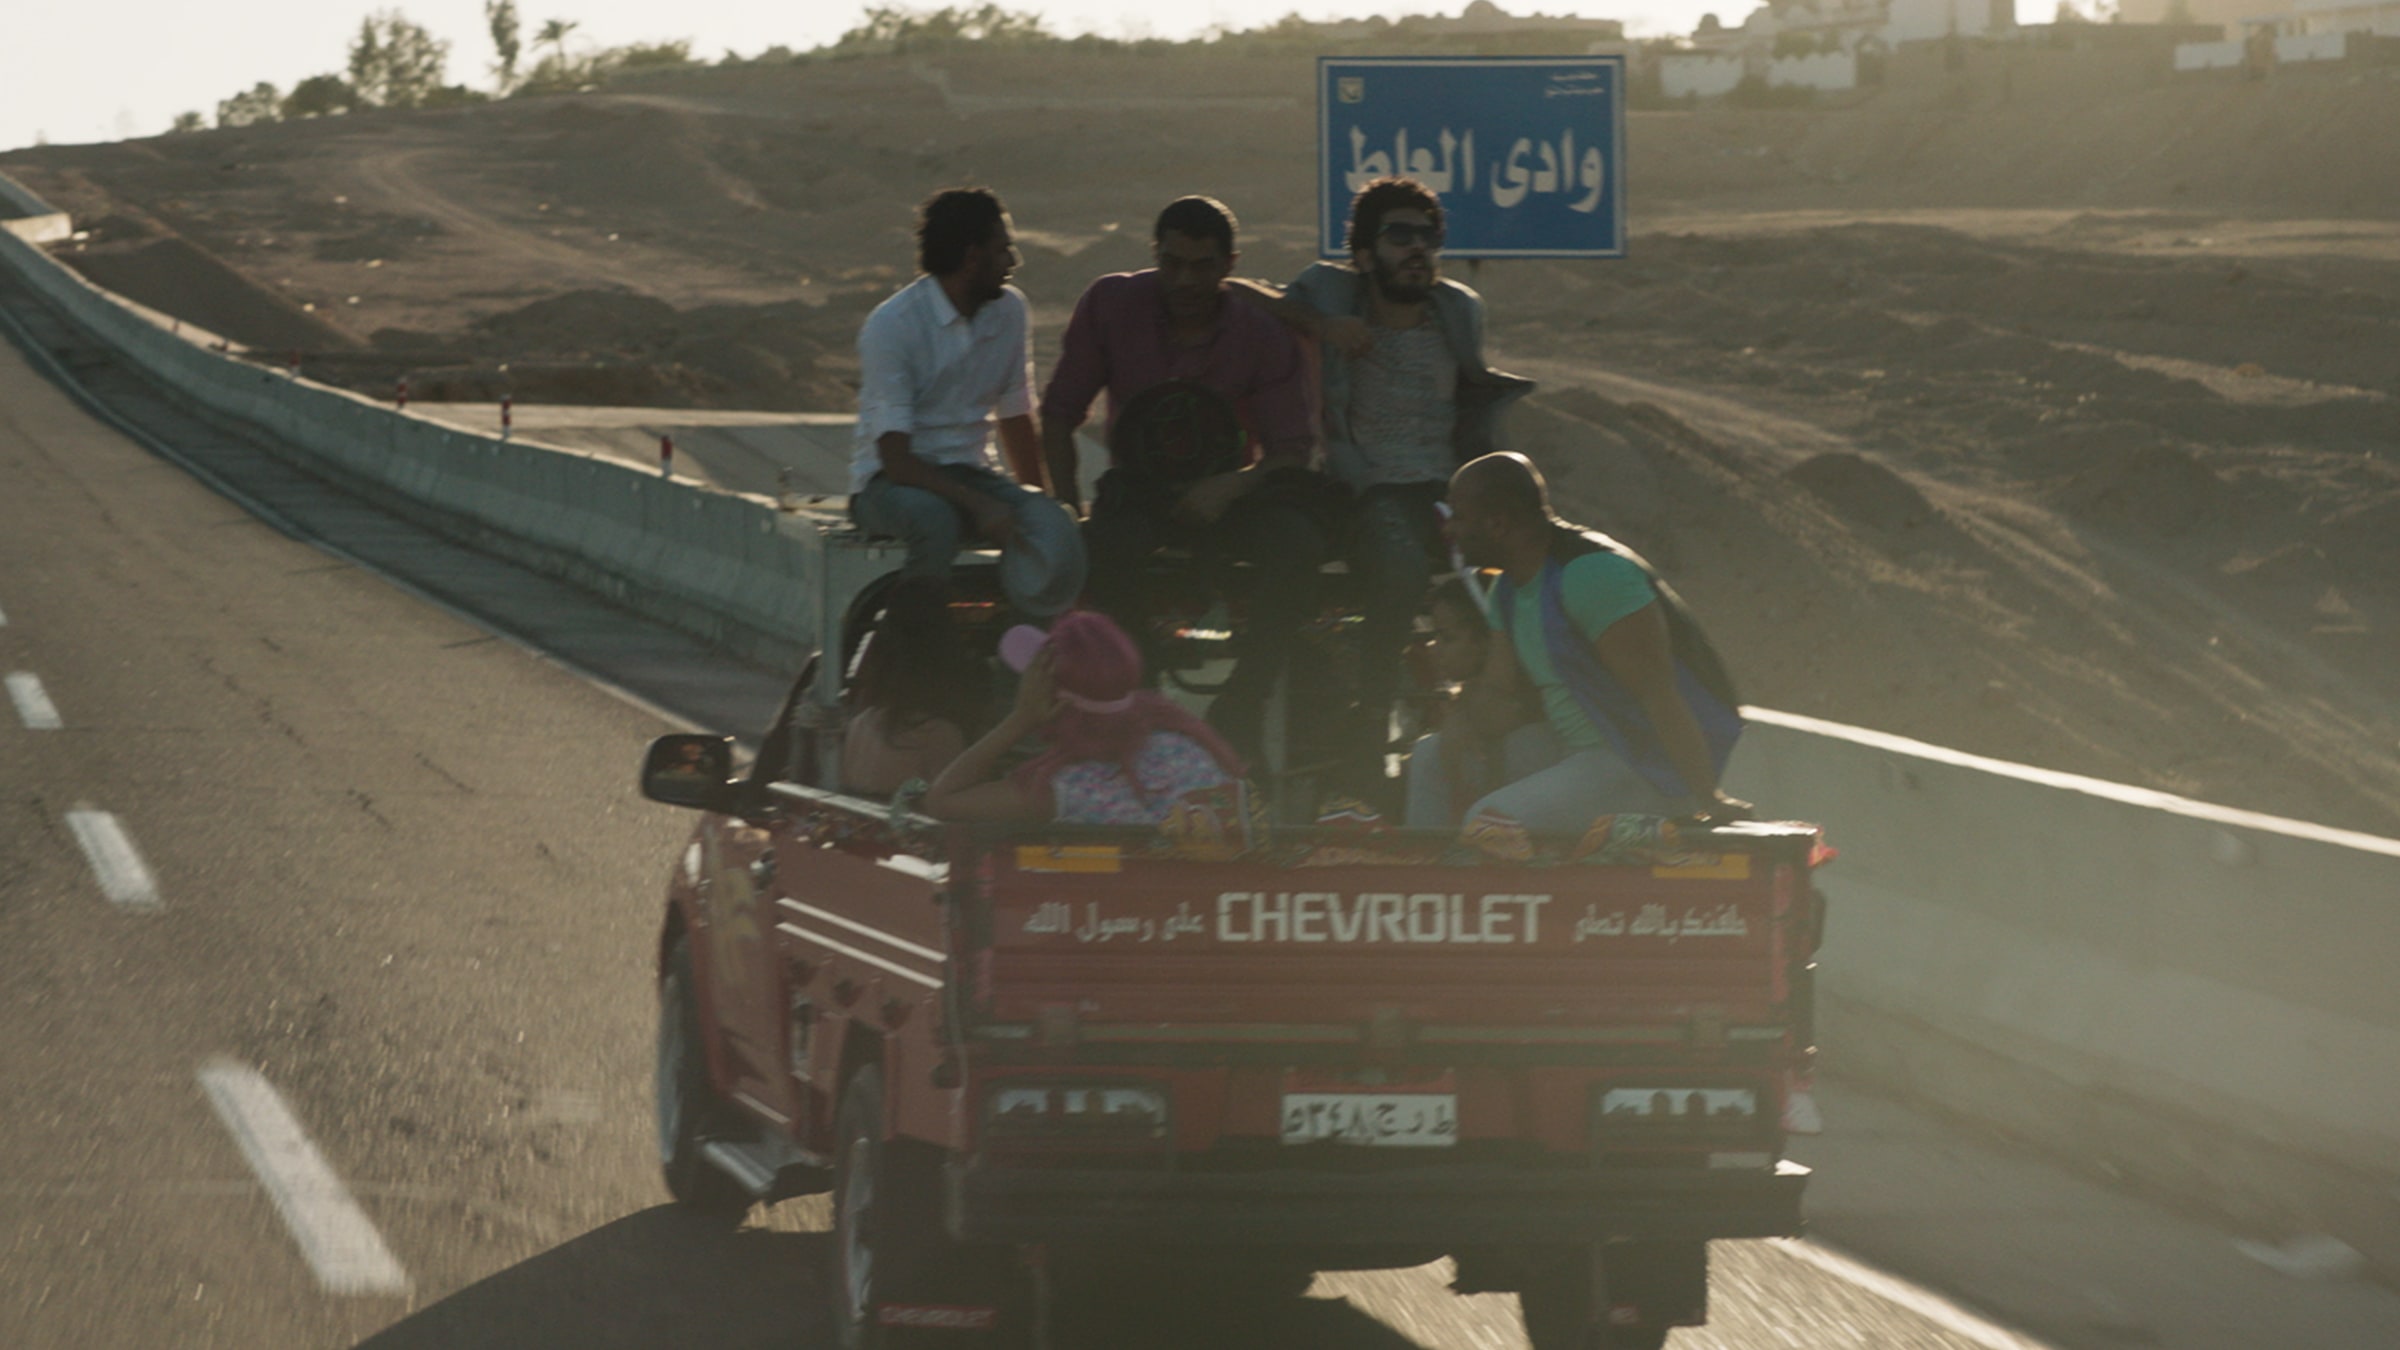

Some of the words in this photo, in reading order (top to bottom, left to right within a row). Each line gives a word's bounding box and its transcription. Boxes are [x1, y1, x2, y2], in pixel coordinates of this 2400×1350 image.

[1022, 901, 1073, 935] الله
[1075, 901, 1156, 944] رسول
[1216, 892, 1551, 944] CHEVROLET
